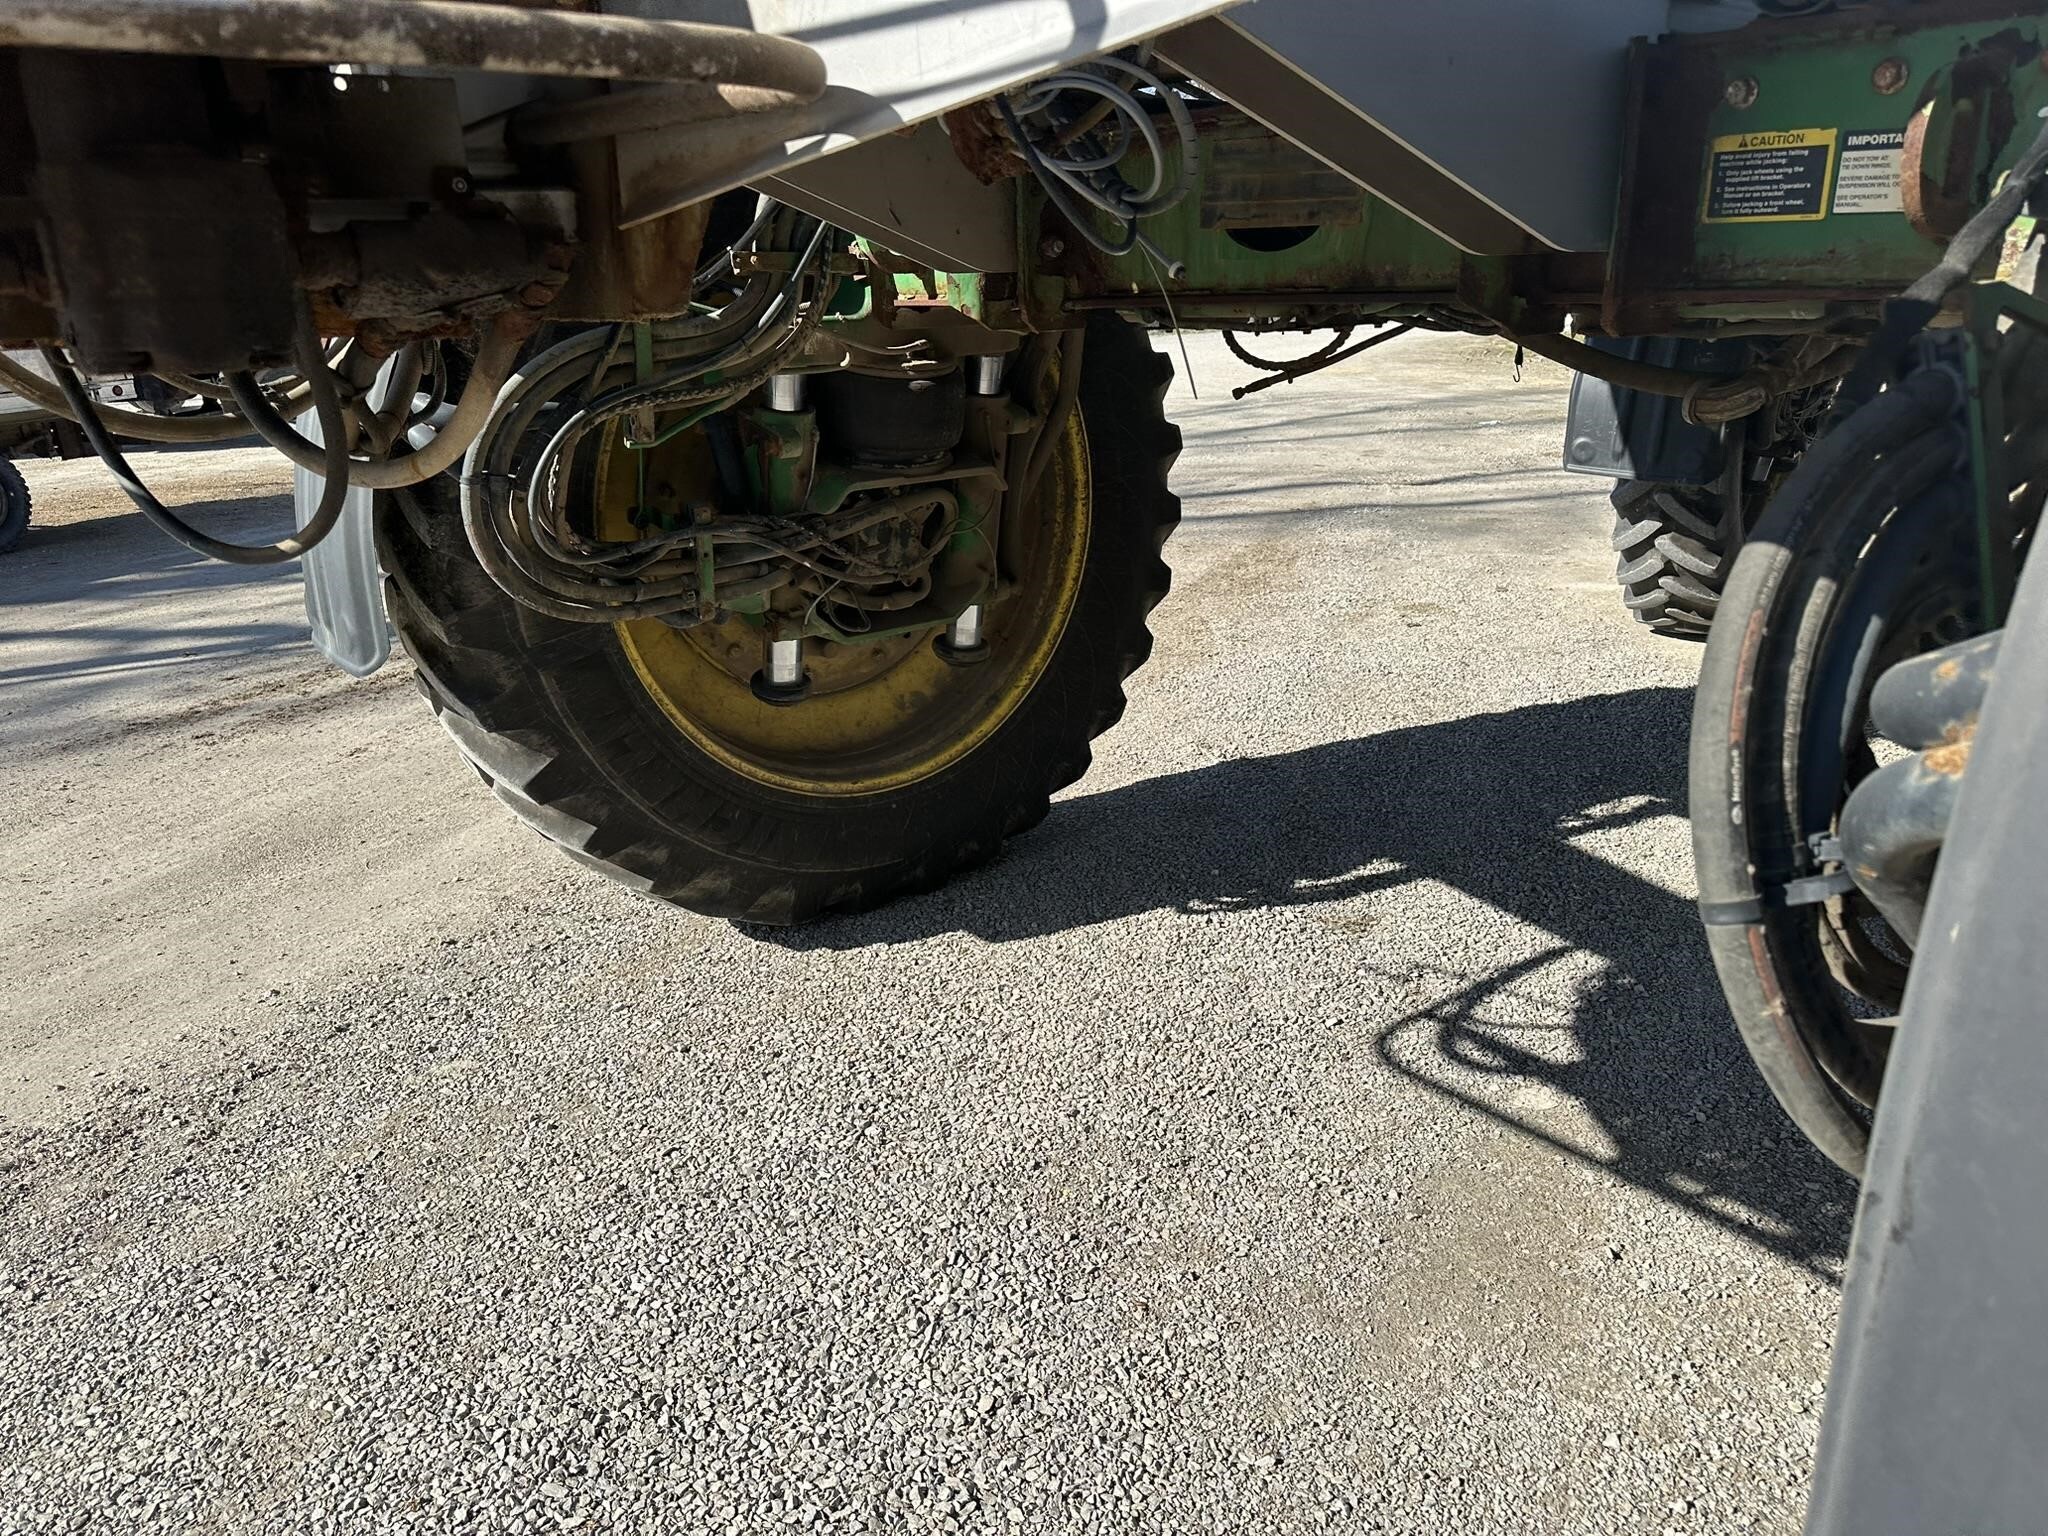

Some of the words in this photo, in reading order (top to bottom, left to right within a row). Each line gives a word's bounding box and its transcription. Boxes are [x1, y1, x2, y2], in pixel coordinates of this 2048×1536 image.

[1750, 133, 1805, 147] CAUTION
[1848, 133, 1903, 146] IMPORTA
[1753, 151, 1771, 159] injury
[1788, 149, 1808, 157] falling
[1779, 182, 1811, 190] Operator's
